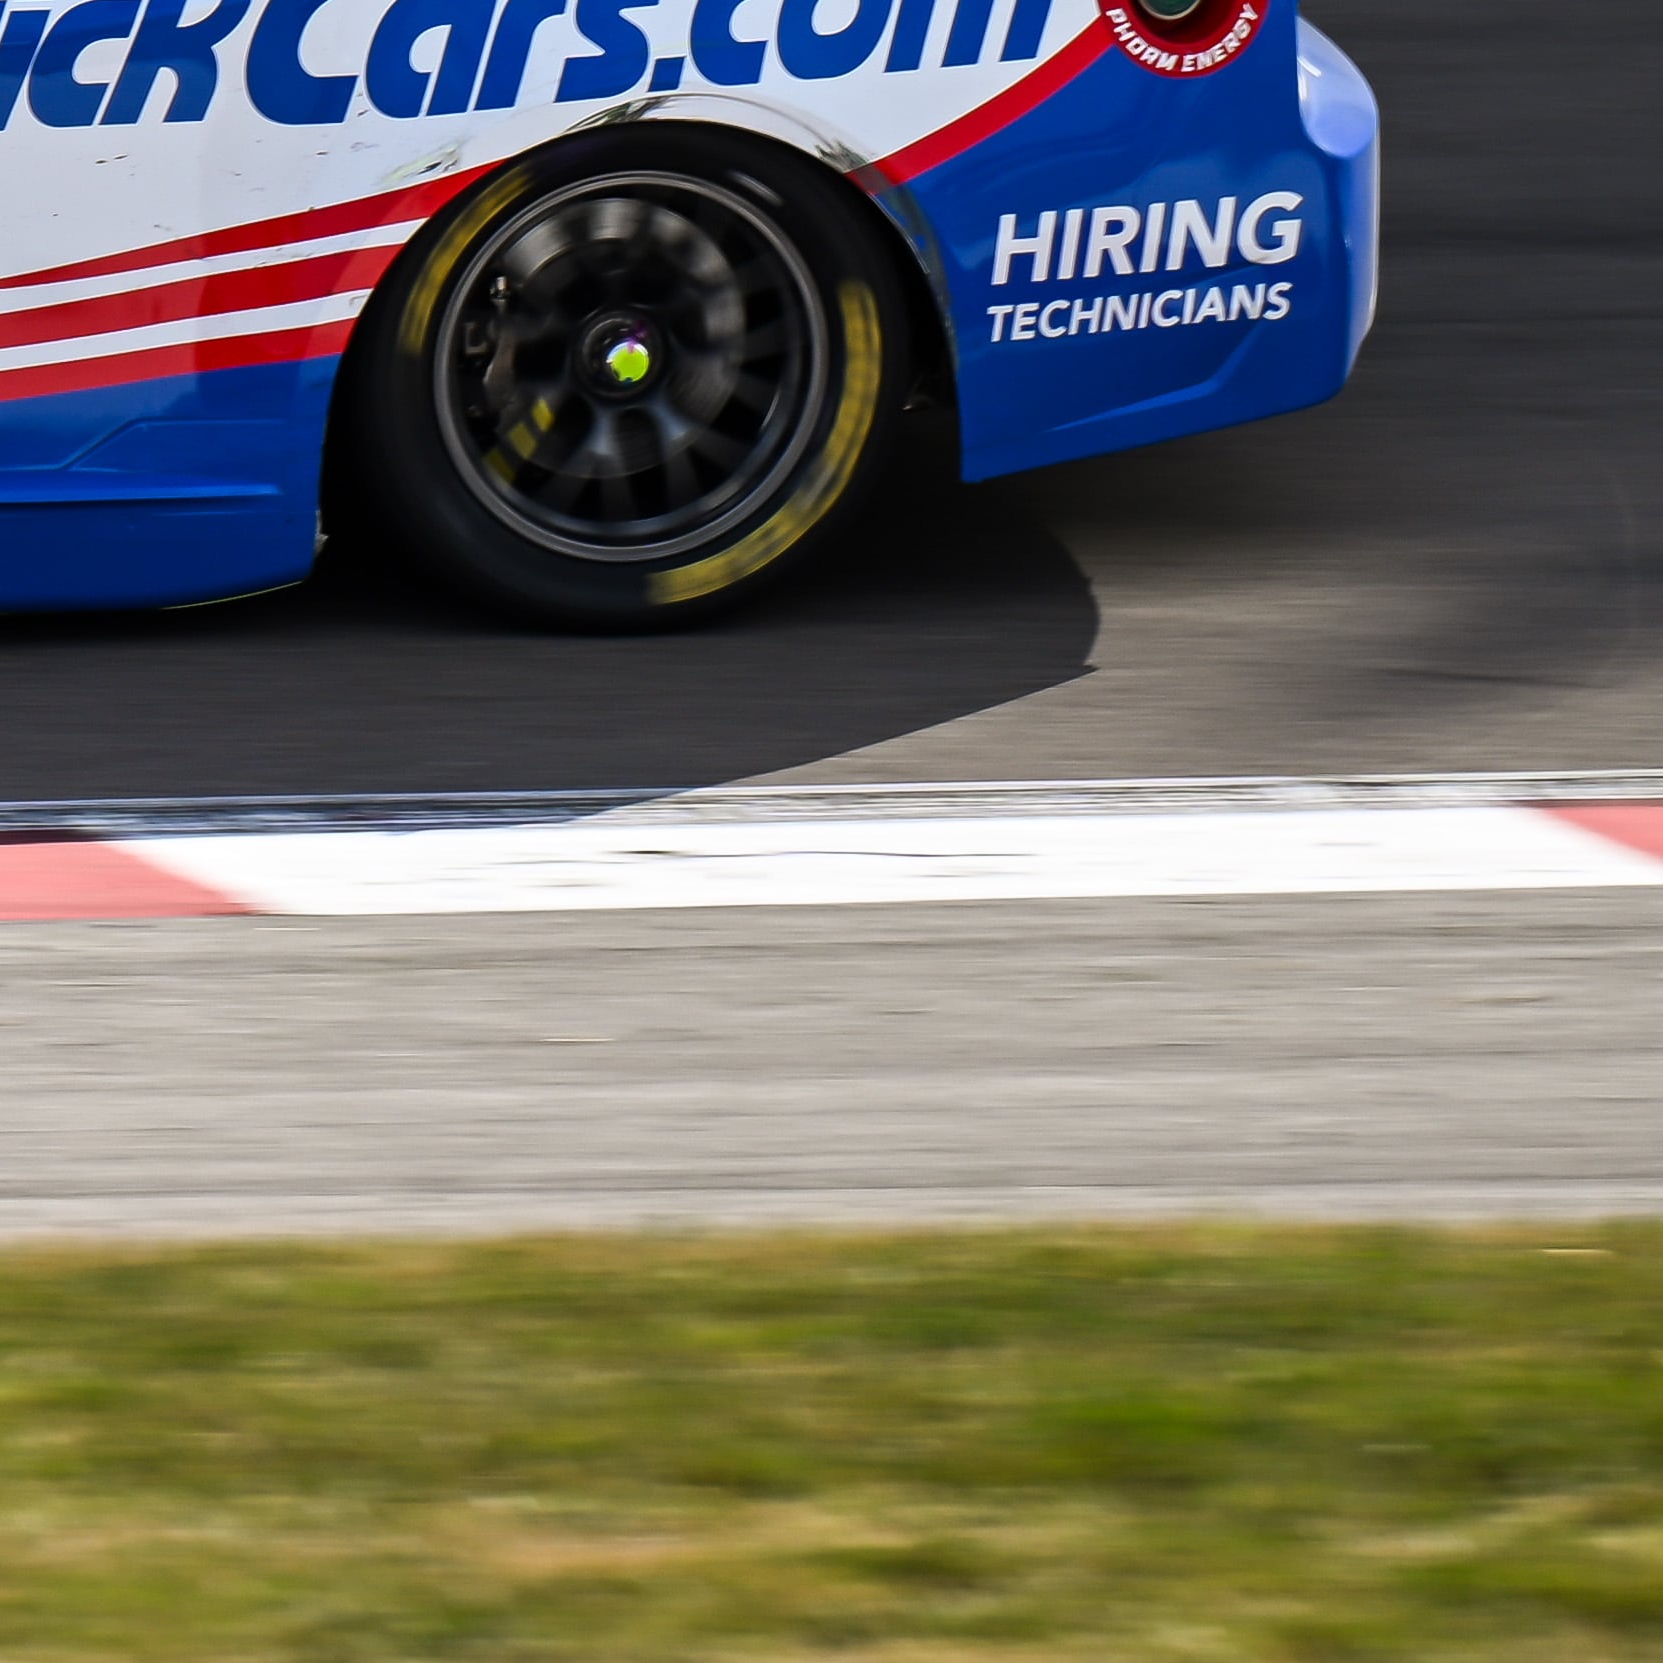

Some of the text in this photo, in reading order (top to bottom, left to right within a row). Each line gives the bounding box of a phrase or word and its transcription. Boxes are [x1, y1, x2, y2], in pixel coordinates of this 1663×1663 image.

[1181, 2, 1259, 72] ENERGY
[990, 192, 1304, 286] HIRING
[987, 281, 1293, 343] TECHNICIANS
